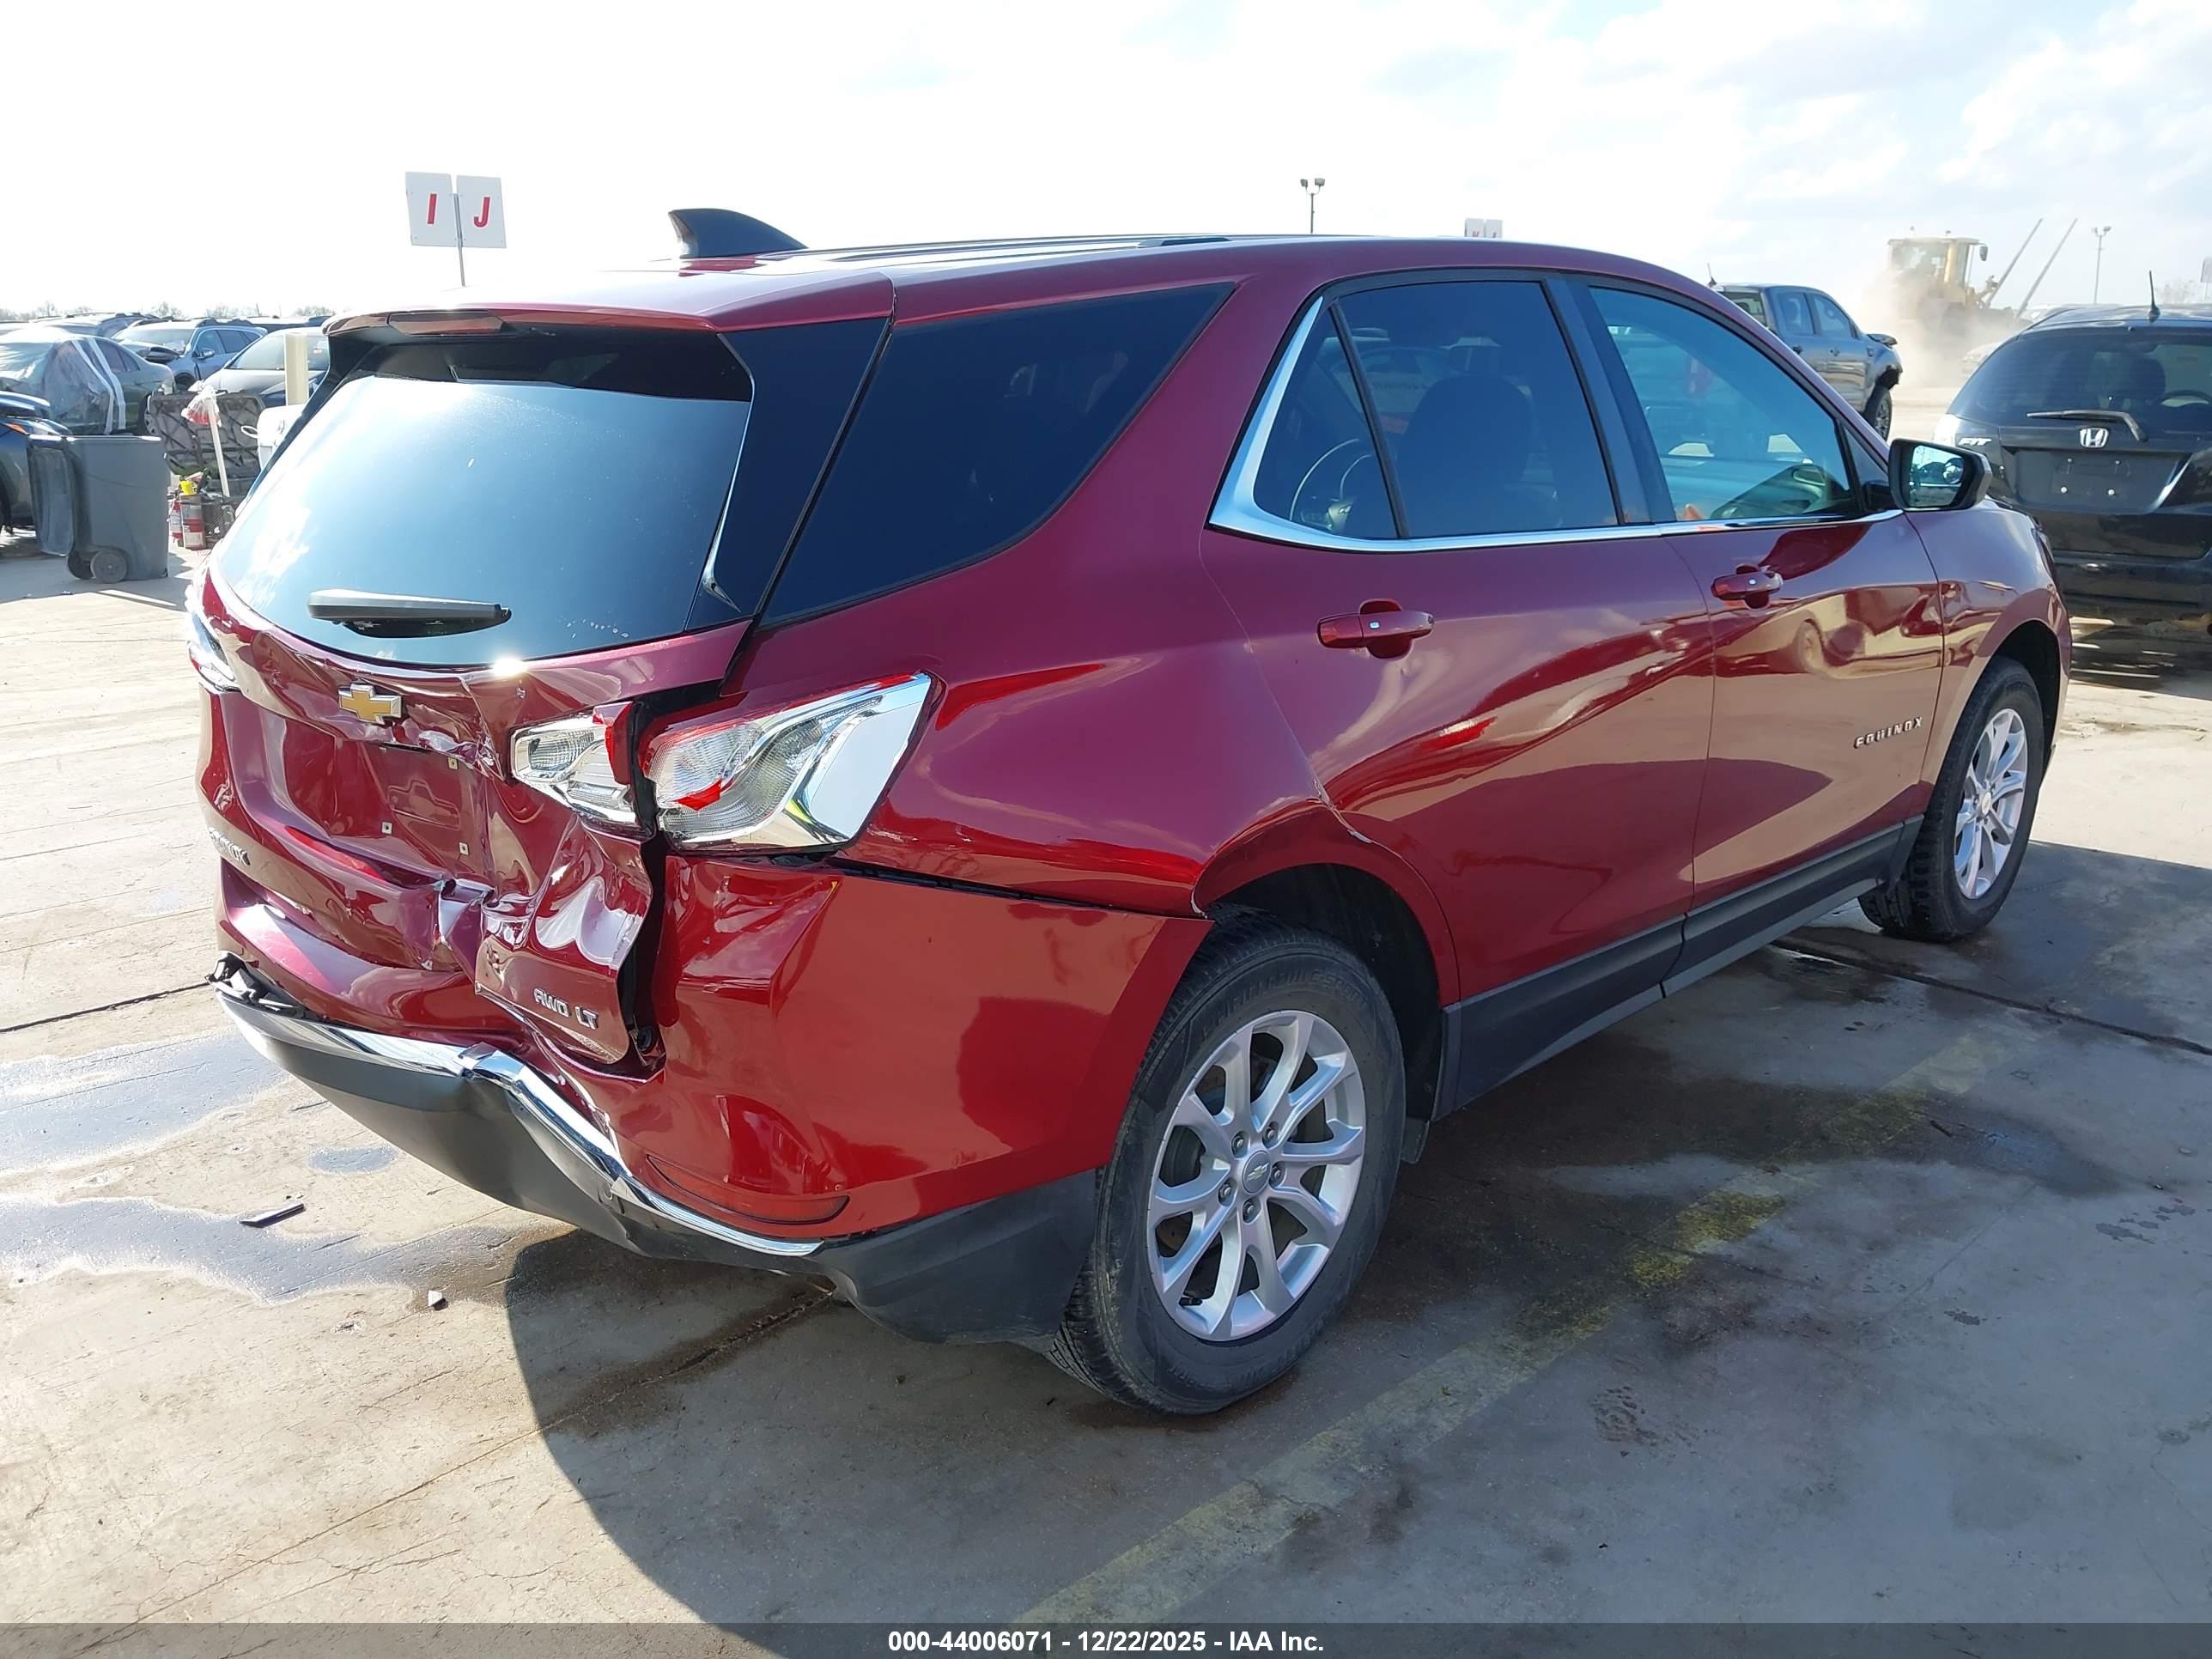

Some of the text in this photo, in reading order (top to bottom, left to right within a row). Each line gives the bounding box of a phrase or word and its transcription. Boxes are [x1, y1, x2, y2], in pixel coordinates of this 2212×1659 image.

[427, 193, 437, 224] I
[473, 197, 490, 228] J
[1854, 716, 1923, 748] EQUINOX
[533, 988, 599, 1030] AWD LT
